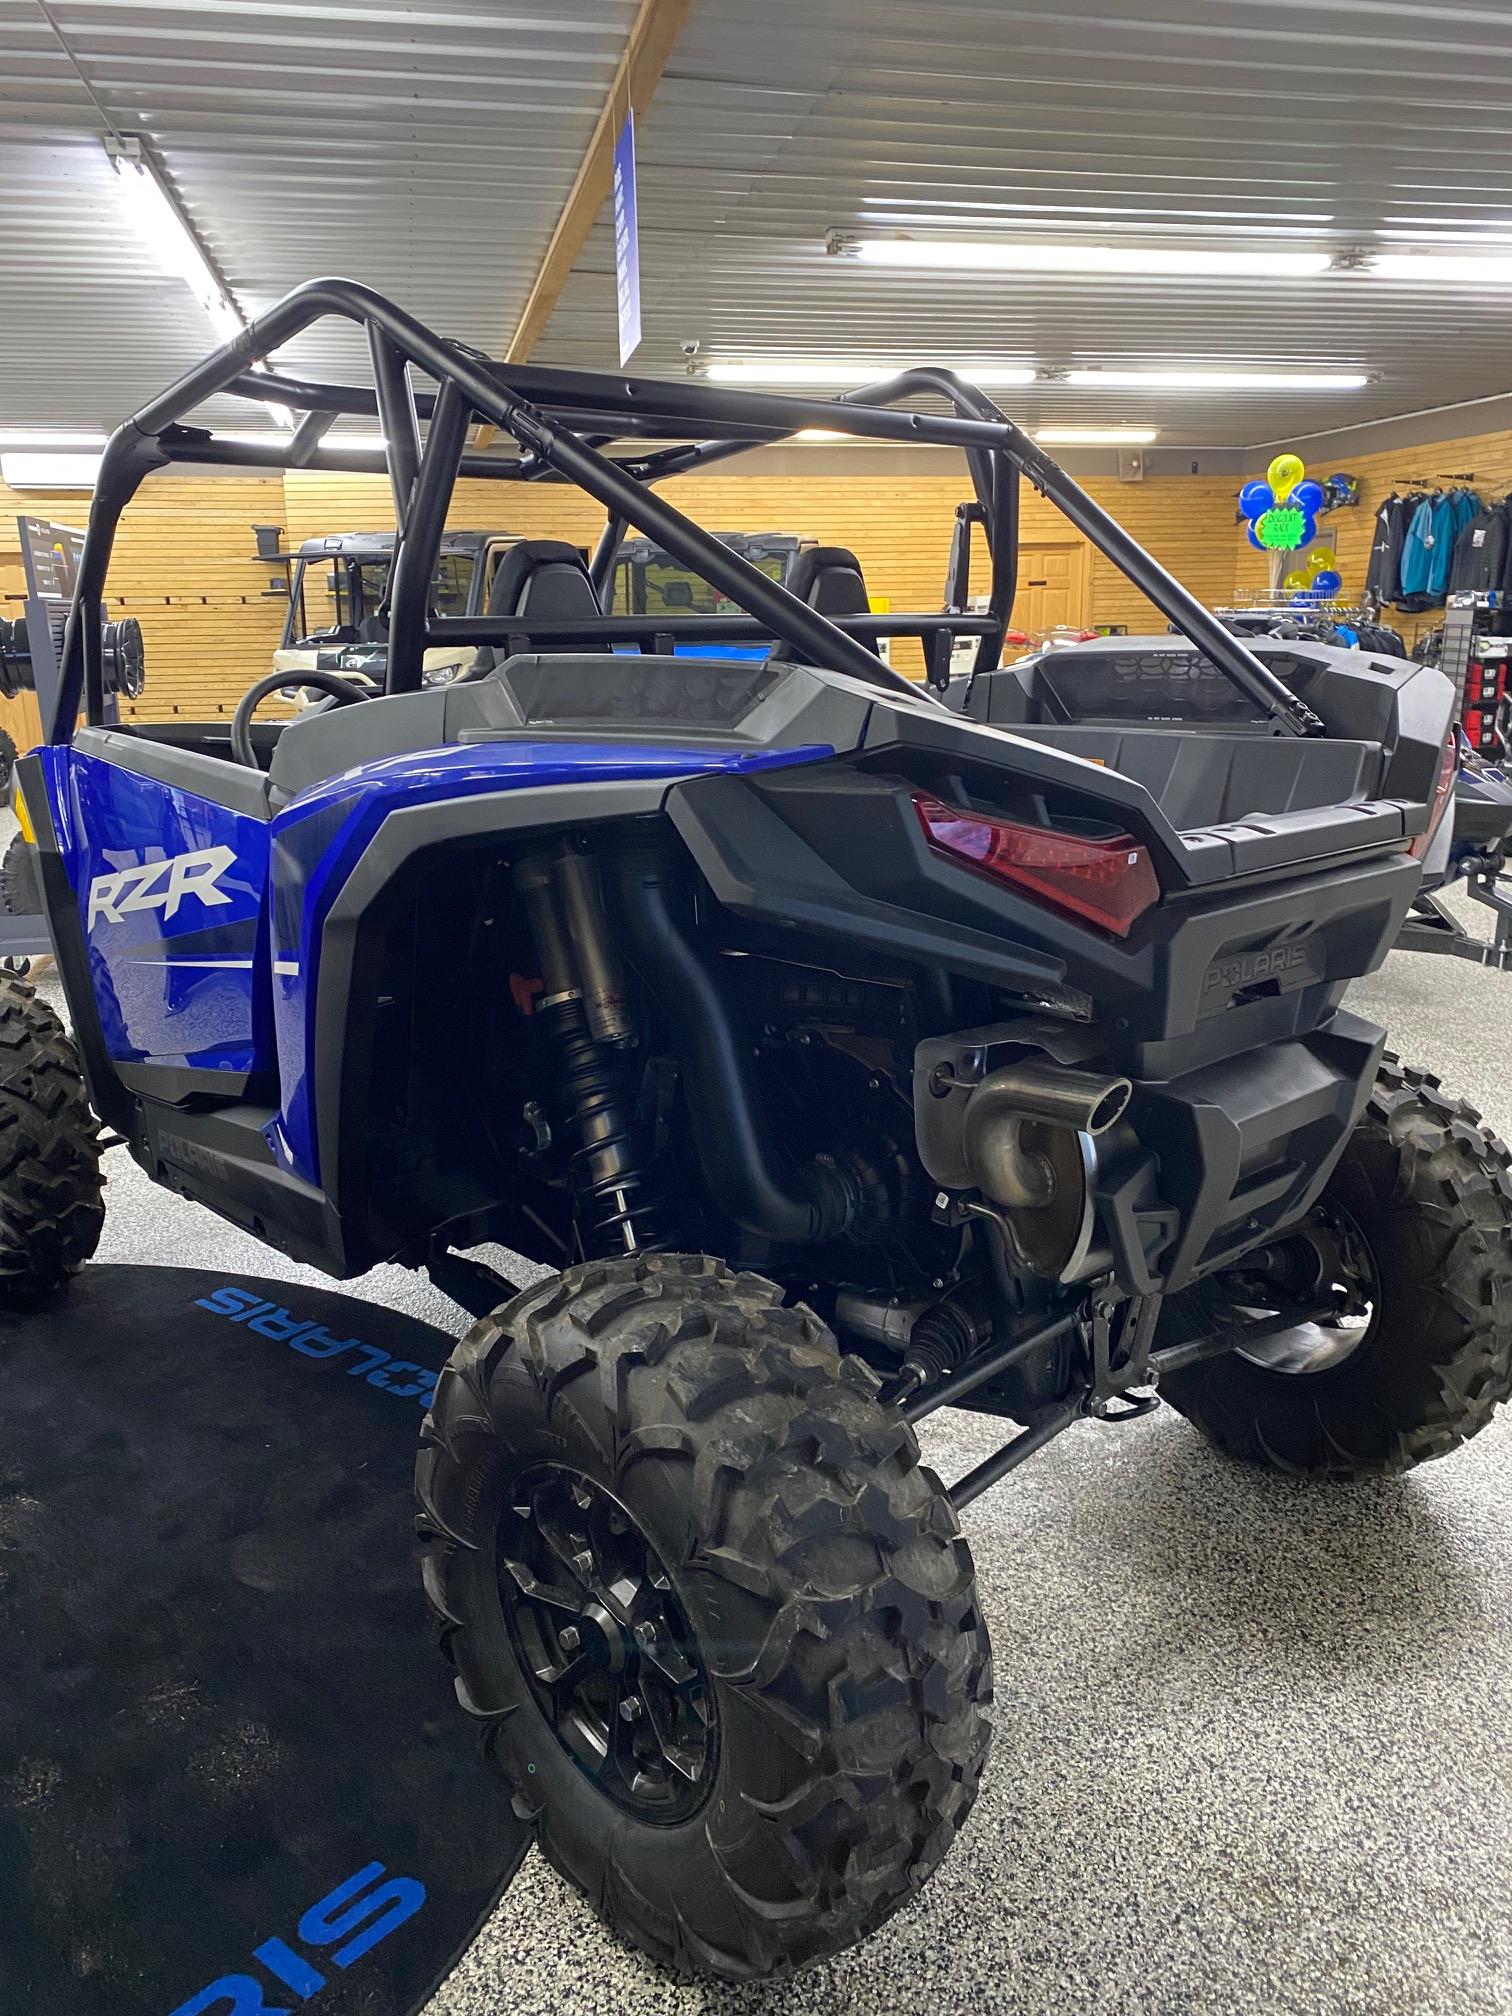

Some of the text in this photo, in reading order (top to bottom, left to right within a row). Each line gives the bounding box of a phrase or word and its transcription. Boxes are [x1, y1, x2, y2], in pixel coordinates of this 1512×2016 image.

[87, 844, 238, 934] RZR
[1204, 944, 1306, 992] POLARIS
[195, 1286, 438, 1408] OLARIS
